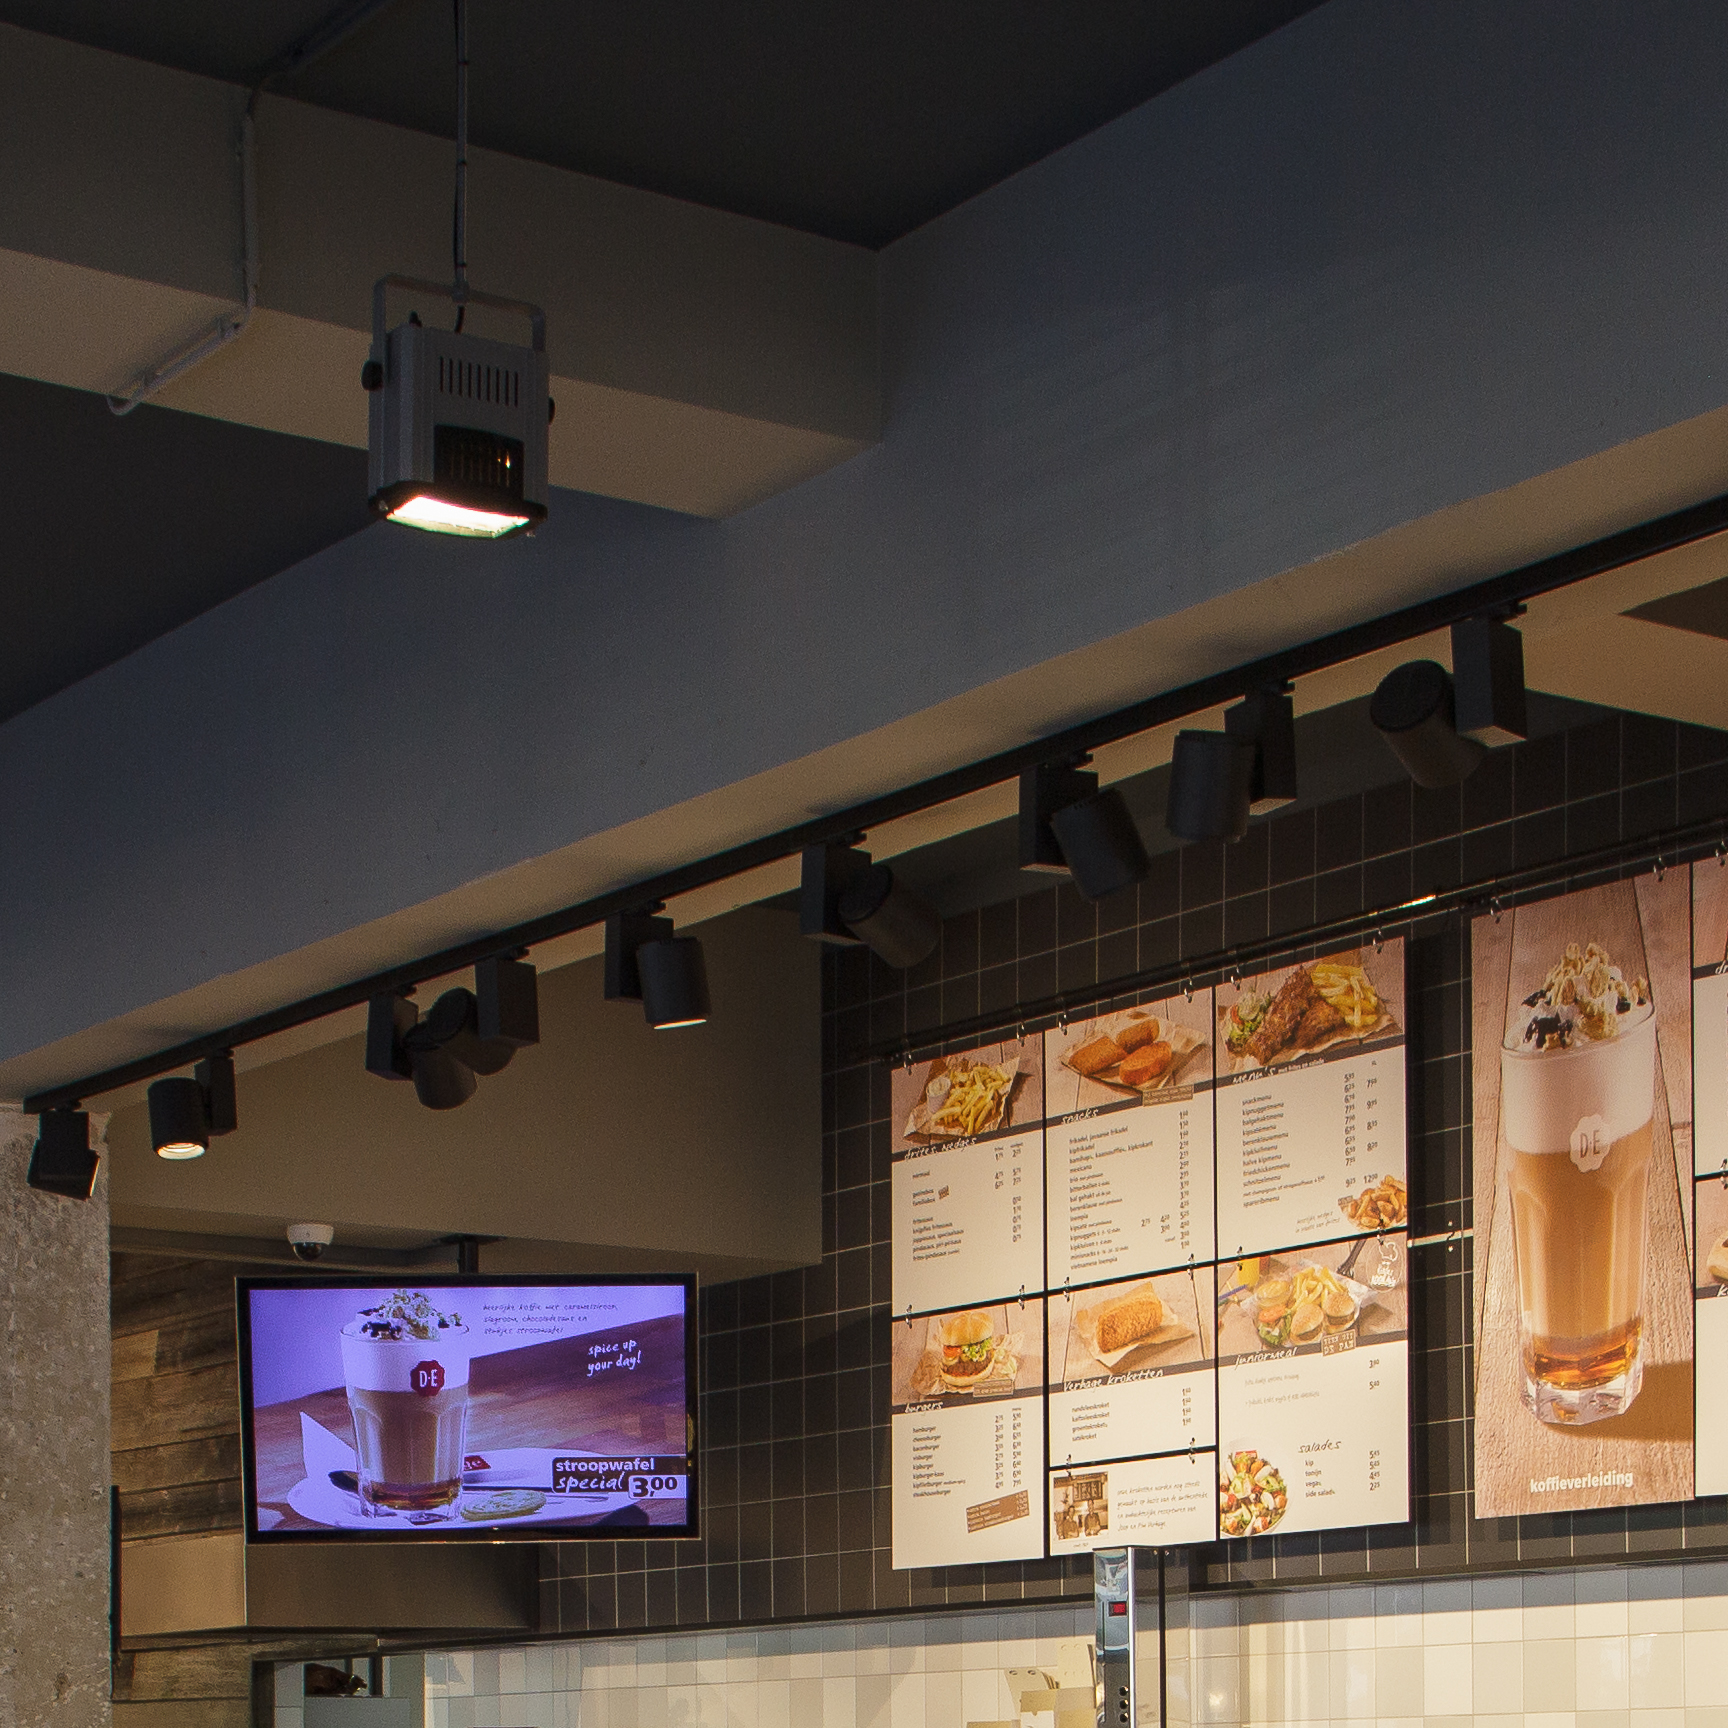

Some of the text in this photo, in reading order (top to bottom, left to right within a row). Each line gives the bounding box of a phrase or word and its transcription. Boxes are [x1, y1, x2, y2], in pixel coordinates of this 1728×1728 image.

[587, 1339, 637, 1358] spice up
[587, 1350, 642, 1378] your day!
[1107, 1369, 1164, 1386] kroketten
[1298, 1439, 1342, 1454] salades
[555, 1457, 655, 1474] stroopwafel
[556, 1471, 626, 1493] special
[1530, 1469, 1633, 1494] koffieverleiding
